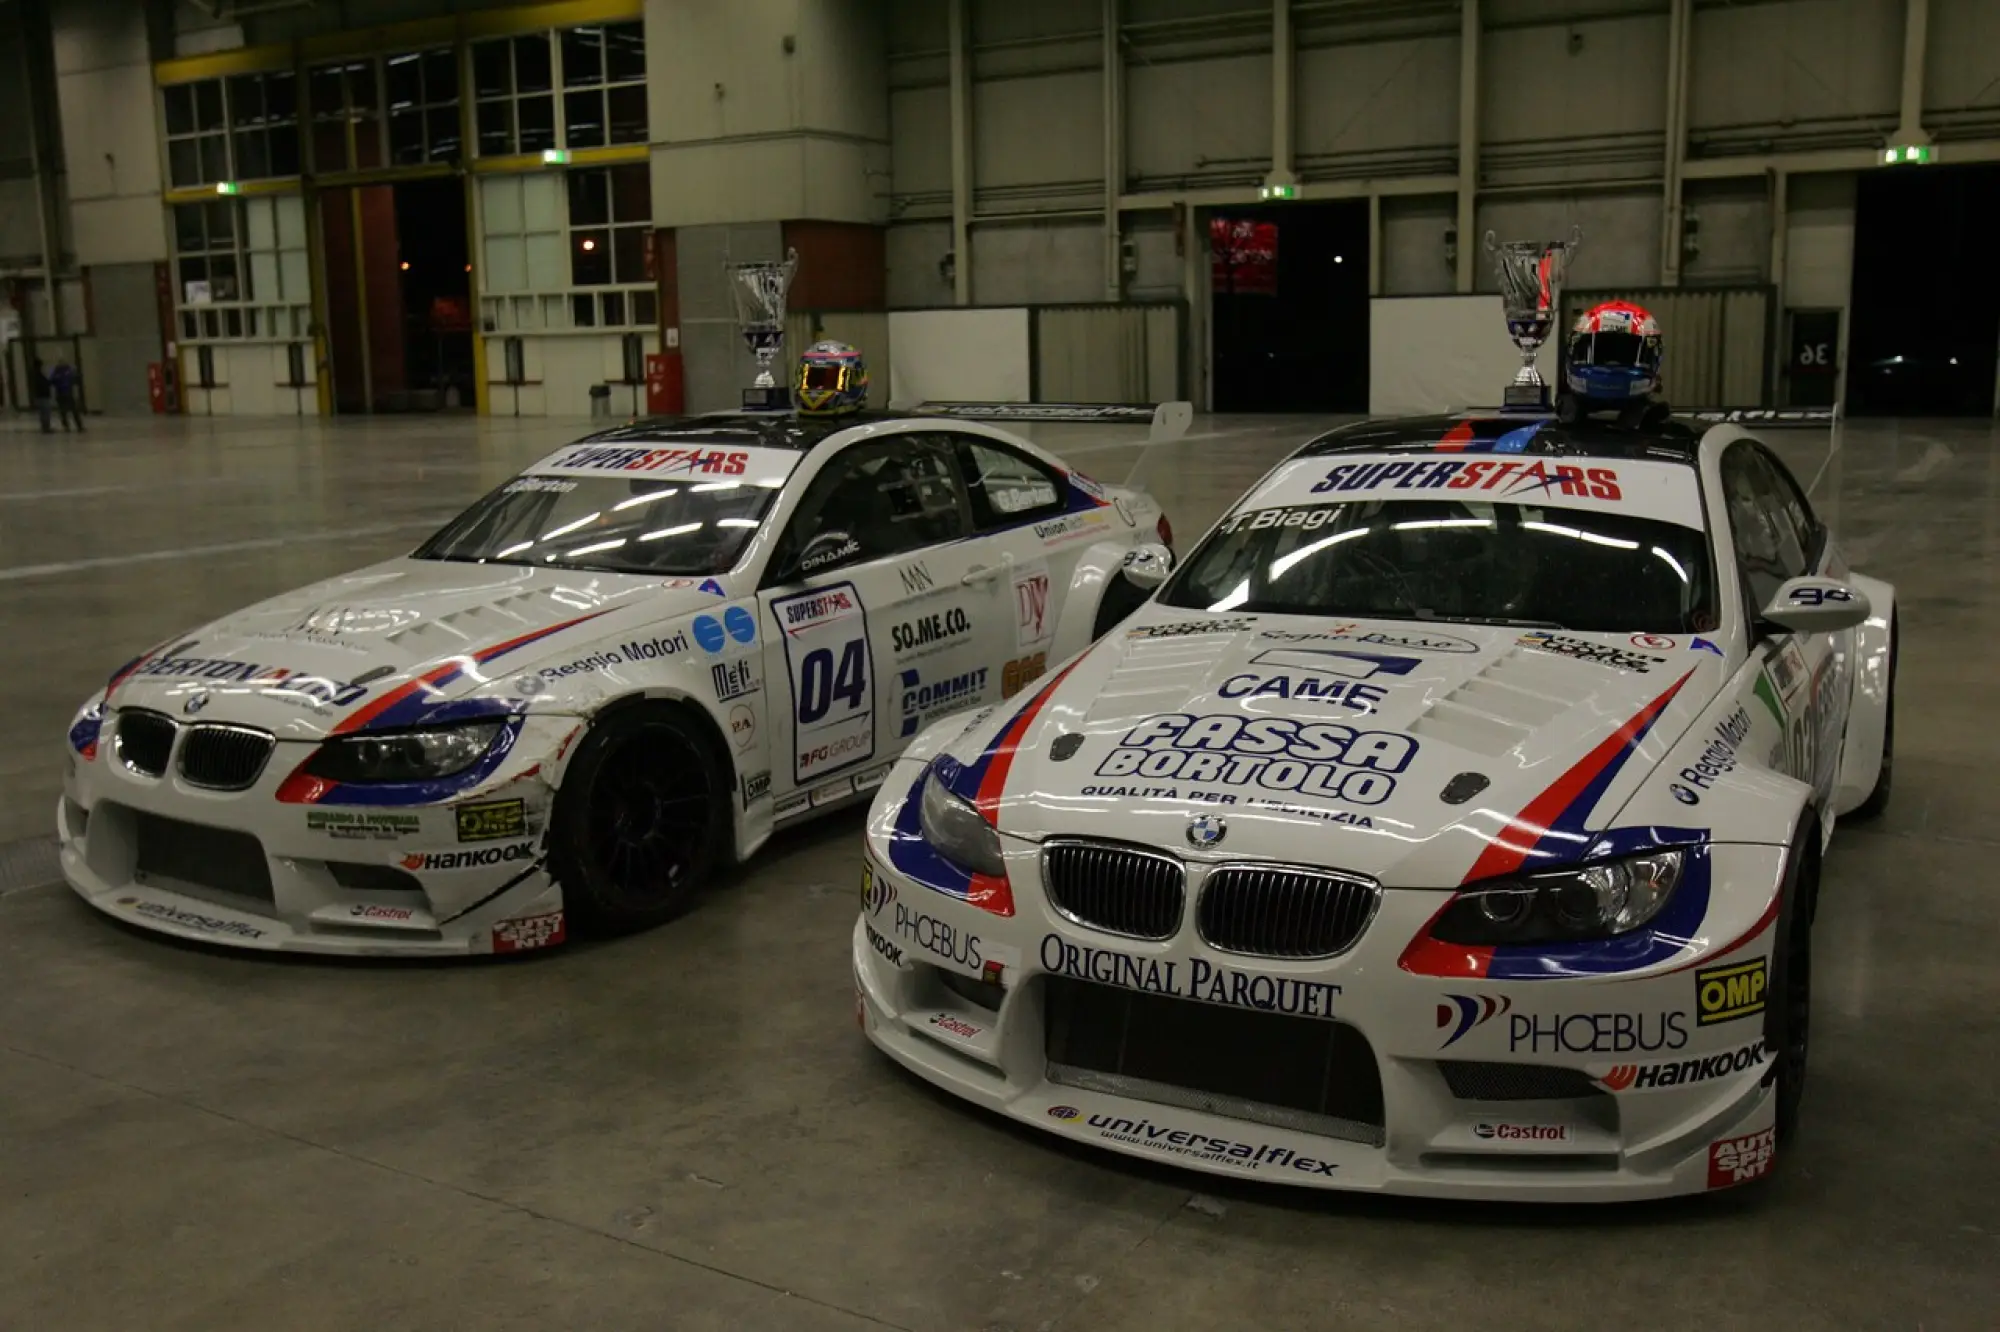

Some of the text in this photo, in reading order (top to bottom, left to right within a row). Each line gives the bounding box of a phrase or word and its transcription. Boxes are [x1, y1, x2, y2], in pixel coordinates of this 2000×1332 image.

[552, 448, 749, 475] SUPERSTARS
[1311, 461, 1622, 501] SUPERSTARS
[1248, 503, 1347, 531] Biagi
[890, 606, 972, 652] SO.ME.CO.
[539, 630, 690, 684] Reggio Motori
[800, 638, 866, 724] 04
[902, 667, 990, 714] COMMIT
[1218, 674, 1390, 714] CAME
[1119, 713, 1420, 774] FASSA
[1080, 785, 1178, 799] QUALITÀ
[1187, 790, 1238, 806] PER
[1094, 748, 1397, 805] BORTOLO
[363, 904, 414, 921] Castrol
[1701, 971, 1766, 1015] OMP
[938, 1018, 982, 1038] Castrol
[1087, 1114, 1341, 1178] universalflex
[1100, 1129, 1260, 1170] www.universalflex.it
[1497, 1123, 1566, 1141] Castrol
